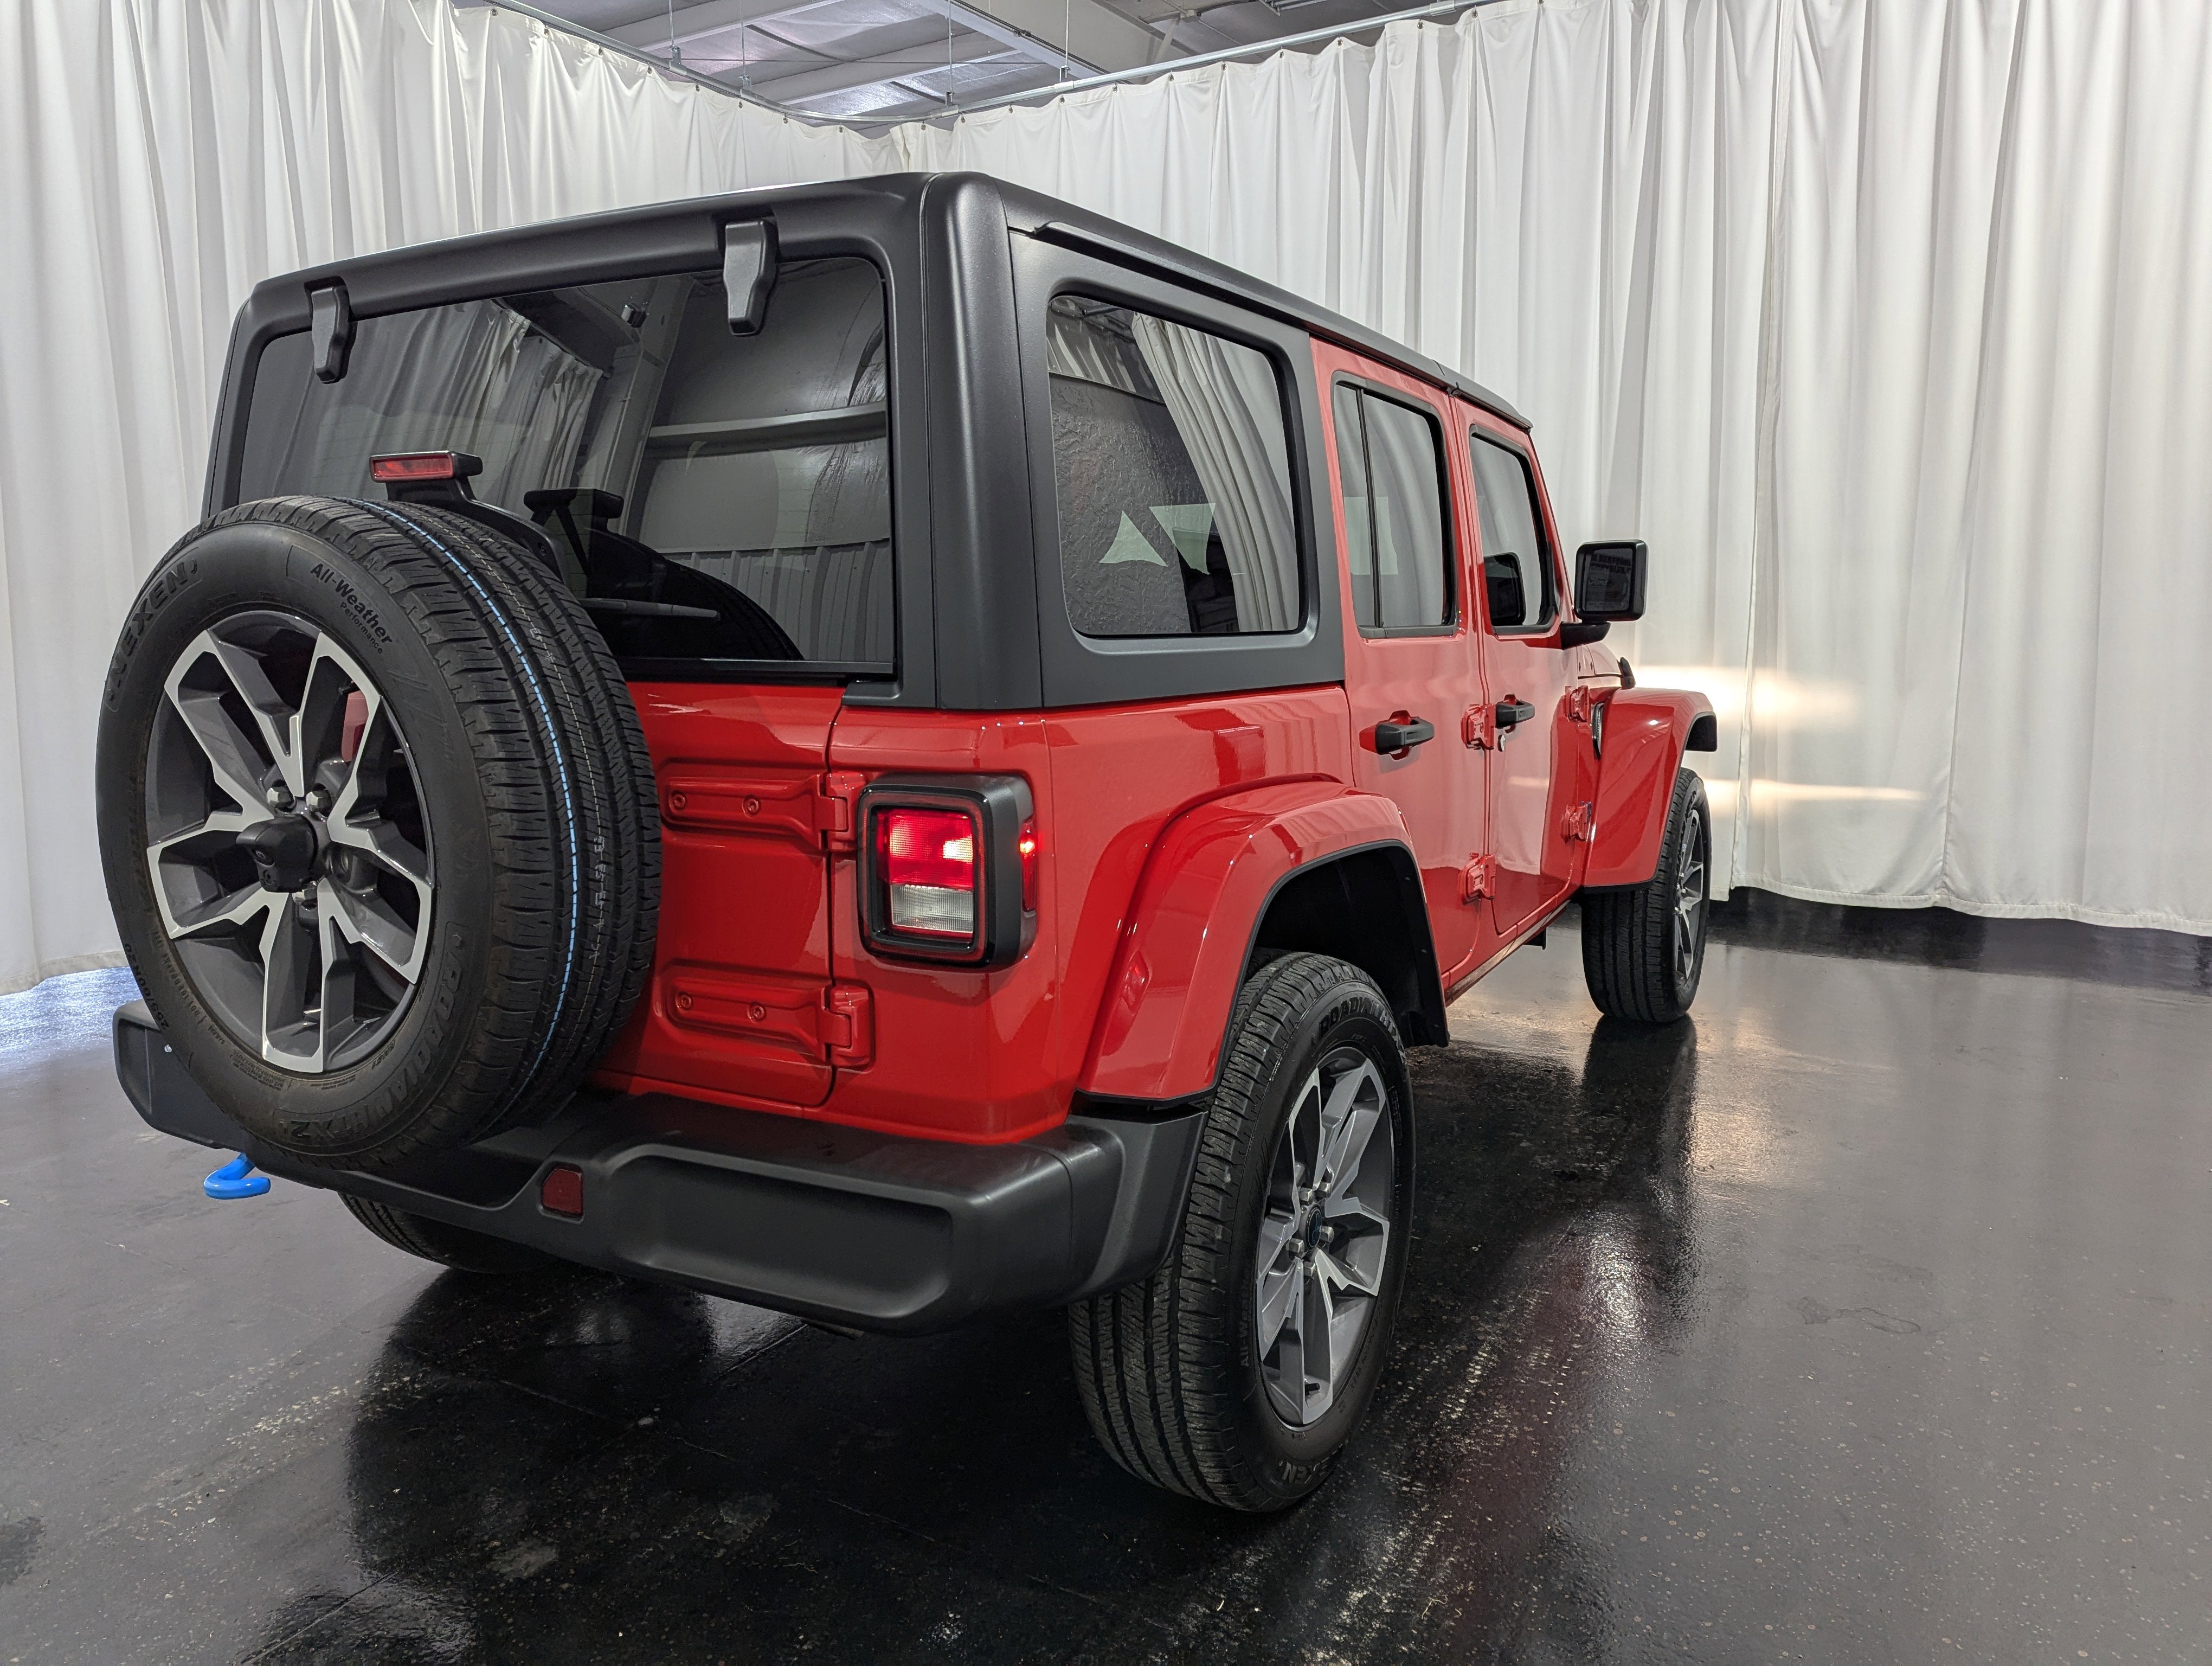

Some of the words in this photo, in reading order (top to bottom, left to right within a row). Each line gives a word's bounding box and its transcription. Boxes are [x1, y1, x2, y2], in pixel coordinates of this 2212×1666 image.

[110, 562, 187, 688] NEXEN
[310, 563, 393, 643] All-Weather
[340, 601, 383, 653] Performance
